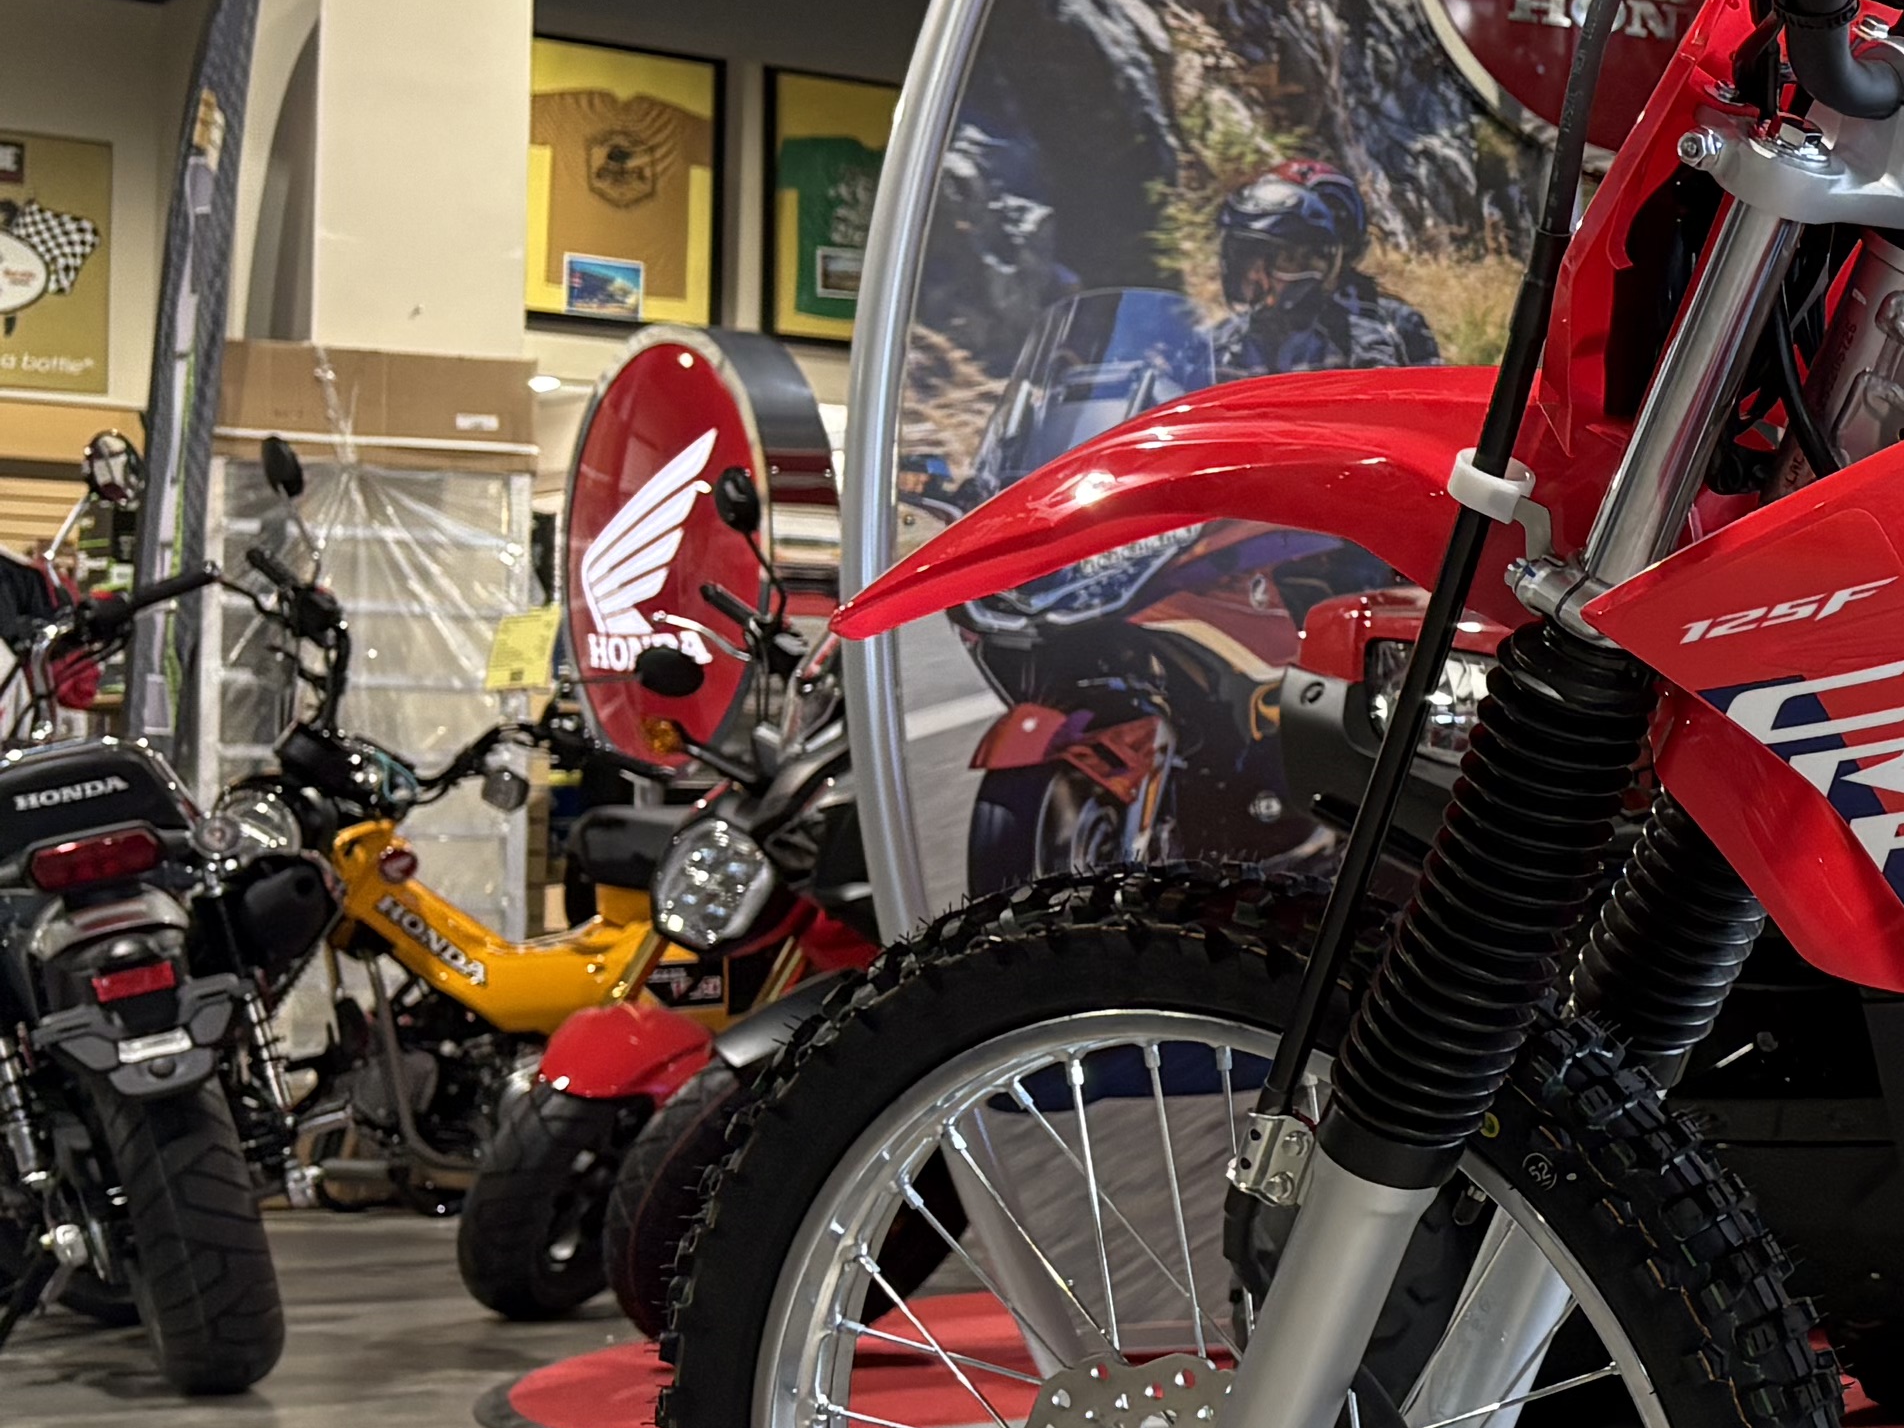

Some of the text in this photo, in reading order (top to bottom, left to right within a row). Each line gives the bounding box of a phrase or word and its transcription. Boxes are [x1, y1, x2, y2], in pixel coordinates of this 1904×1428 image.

[1680, 575, 1900, 645] 125F
[12, 775, 130, 812] HONDA
[376, 895, 486, 986] HONDA
[1528, 1161, 1552, 1183] 52
